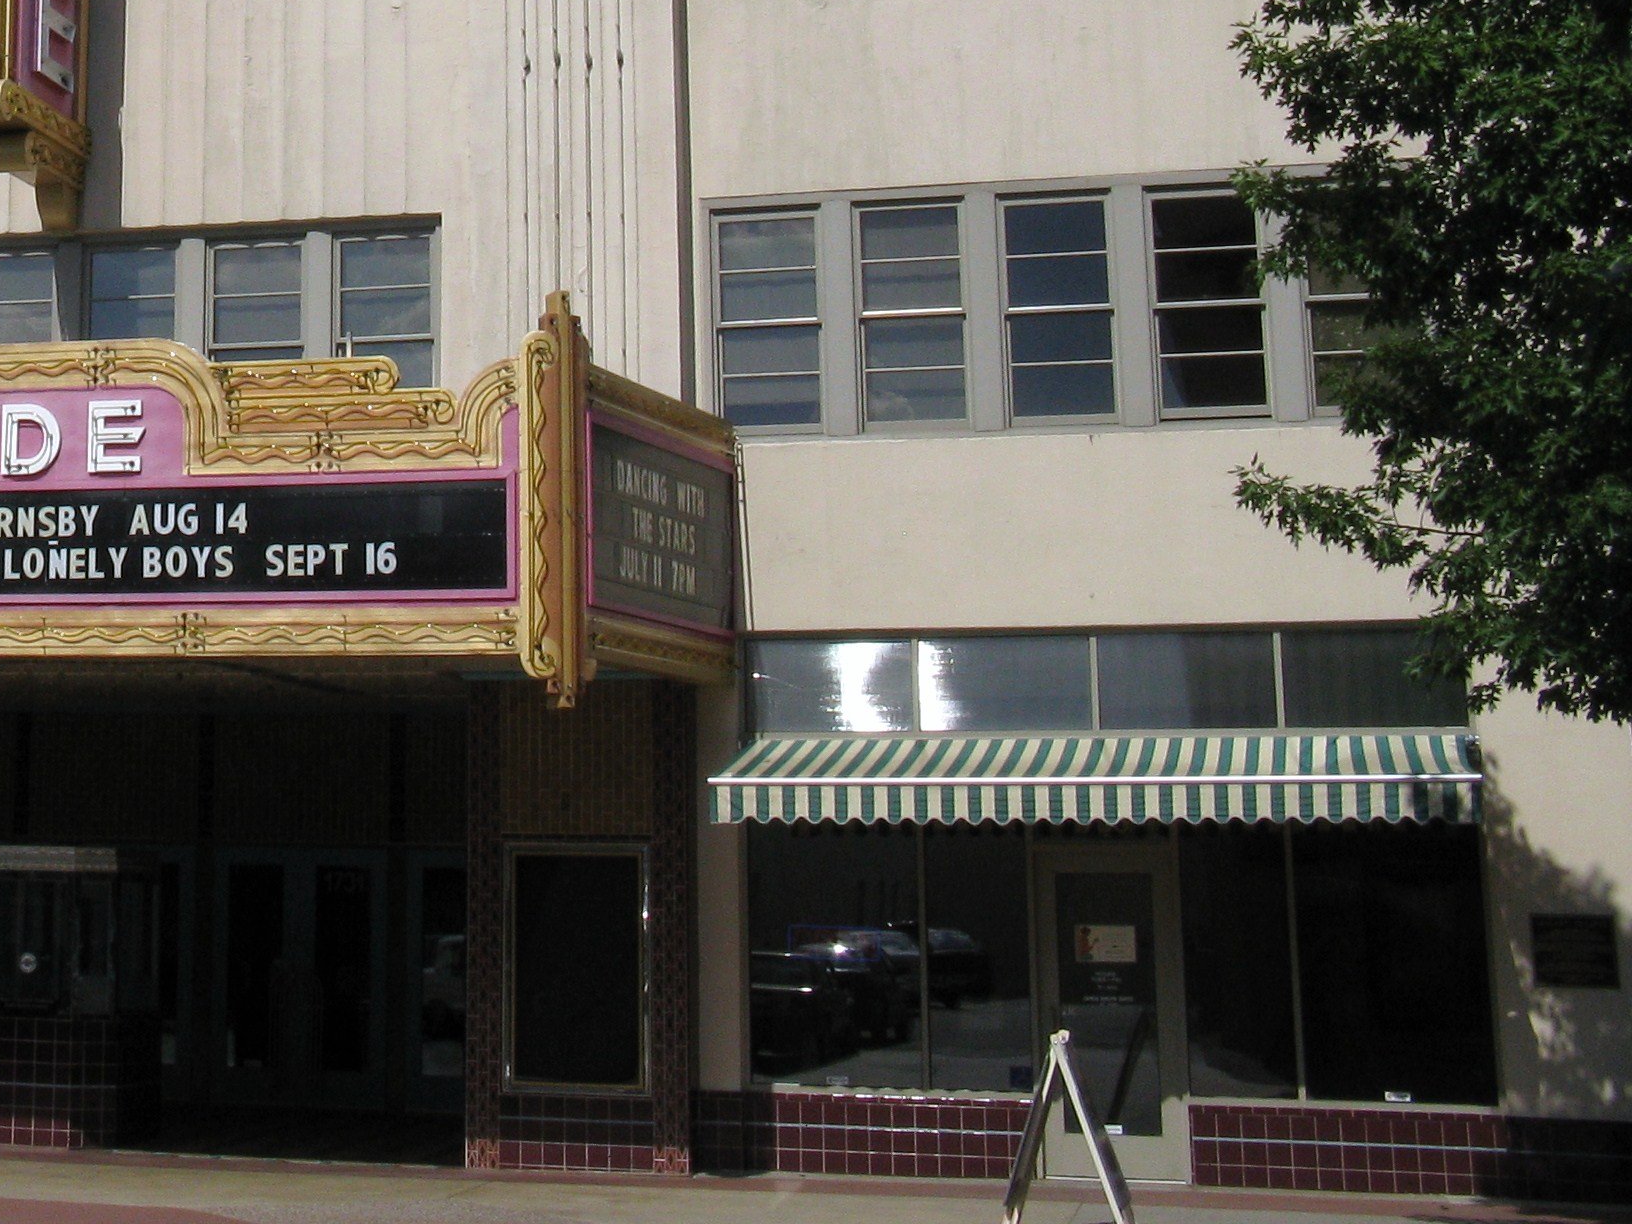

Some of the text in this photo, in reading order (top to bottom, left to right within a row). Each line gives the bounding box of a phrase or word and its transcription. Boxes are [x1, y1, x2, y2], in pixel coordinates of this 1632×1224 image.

[617, 459, 704, 518] DANCING WITH
[129, 503, 198, 535] AUG
[216, 502, 248, 534] 14
[632, 507, 696, 555] THE STARS
[4, 545, 126, 579] LONELY
[142, 545, 234, 577] BOYS
[266, 543, 349, 575] SEPT
[366, 542, 398, 574] 16
[620, 547, 648, 583] JULY
